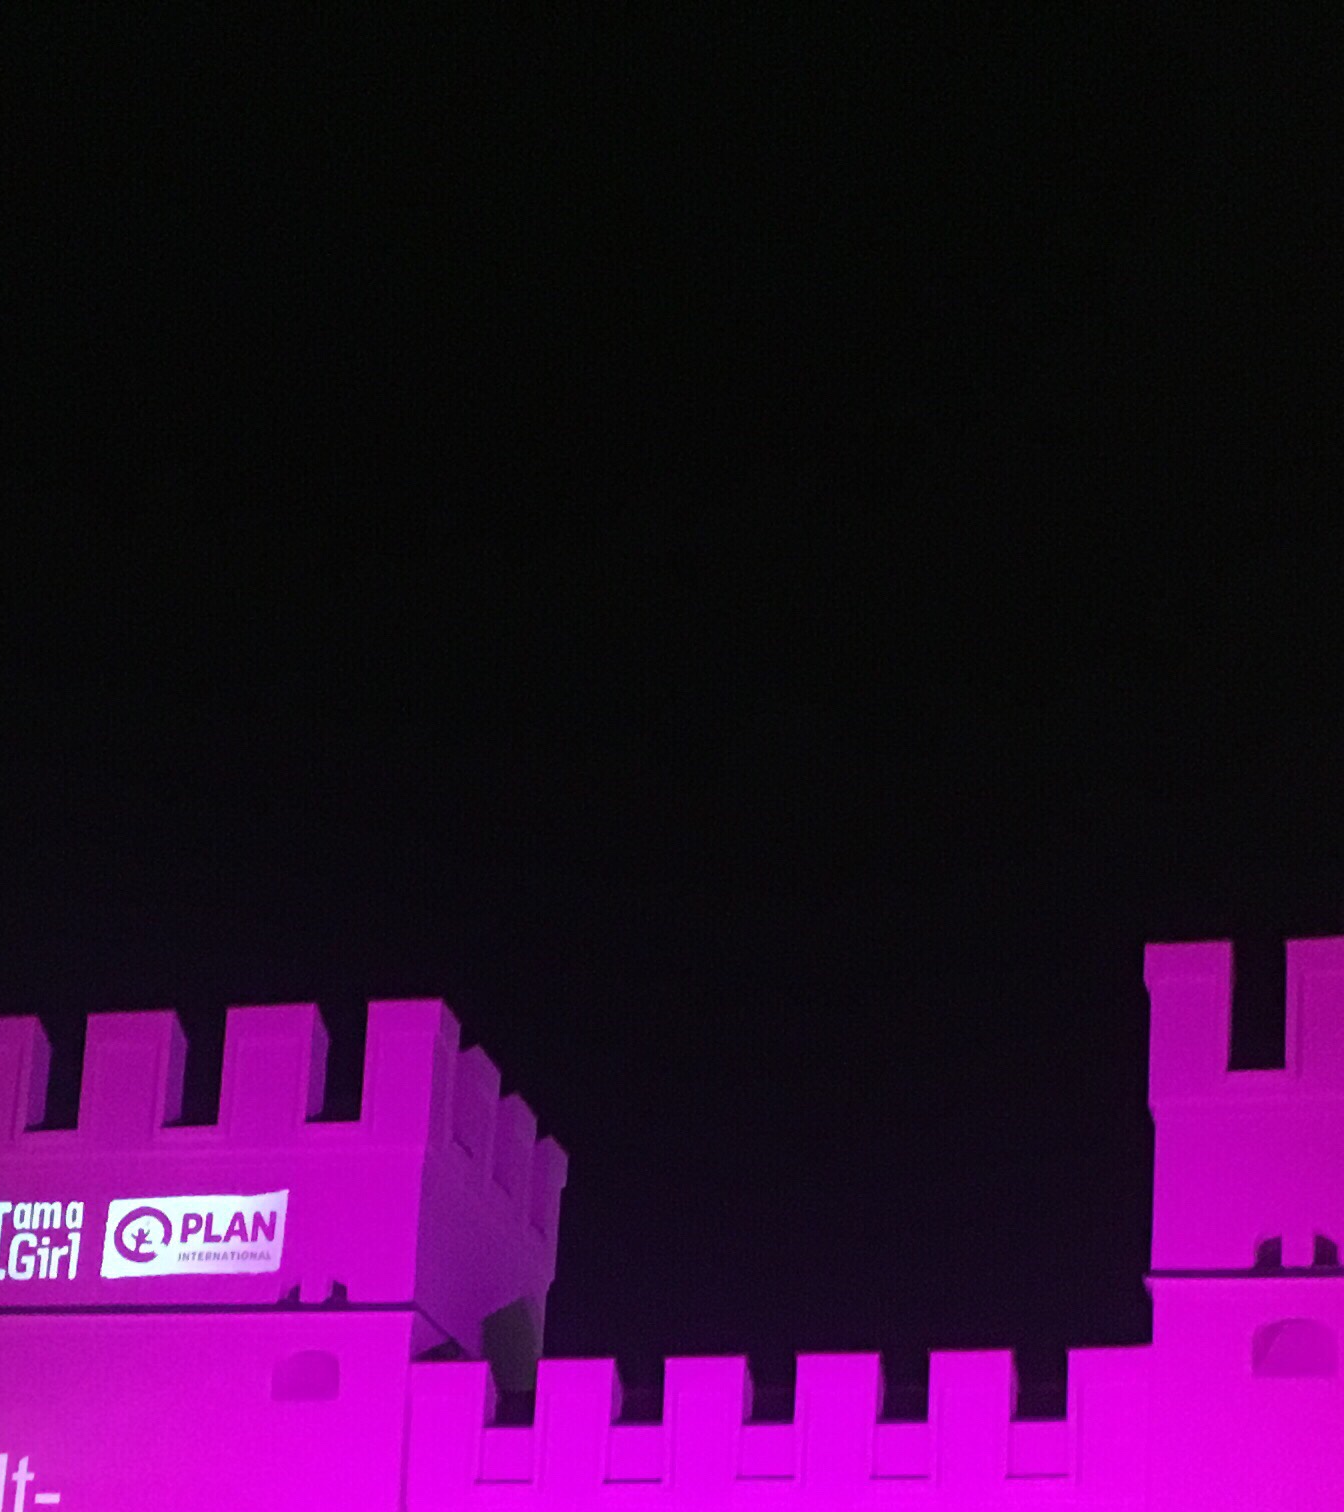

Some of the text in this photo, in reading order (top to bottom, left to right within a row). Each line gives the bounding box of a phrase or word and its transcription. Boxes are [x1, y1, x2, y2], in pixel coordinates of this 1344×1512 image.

[13, 1201, 63, 1231] am
[65, 1201, 84, 1231] a
[180, 1210, 278, 1244] PLAN
[7, 1231, 81, 1281] Girl
[177, 1250, 272, 1263] INTERNATIONAL
